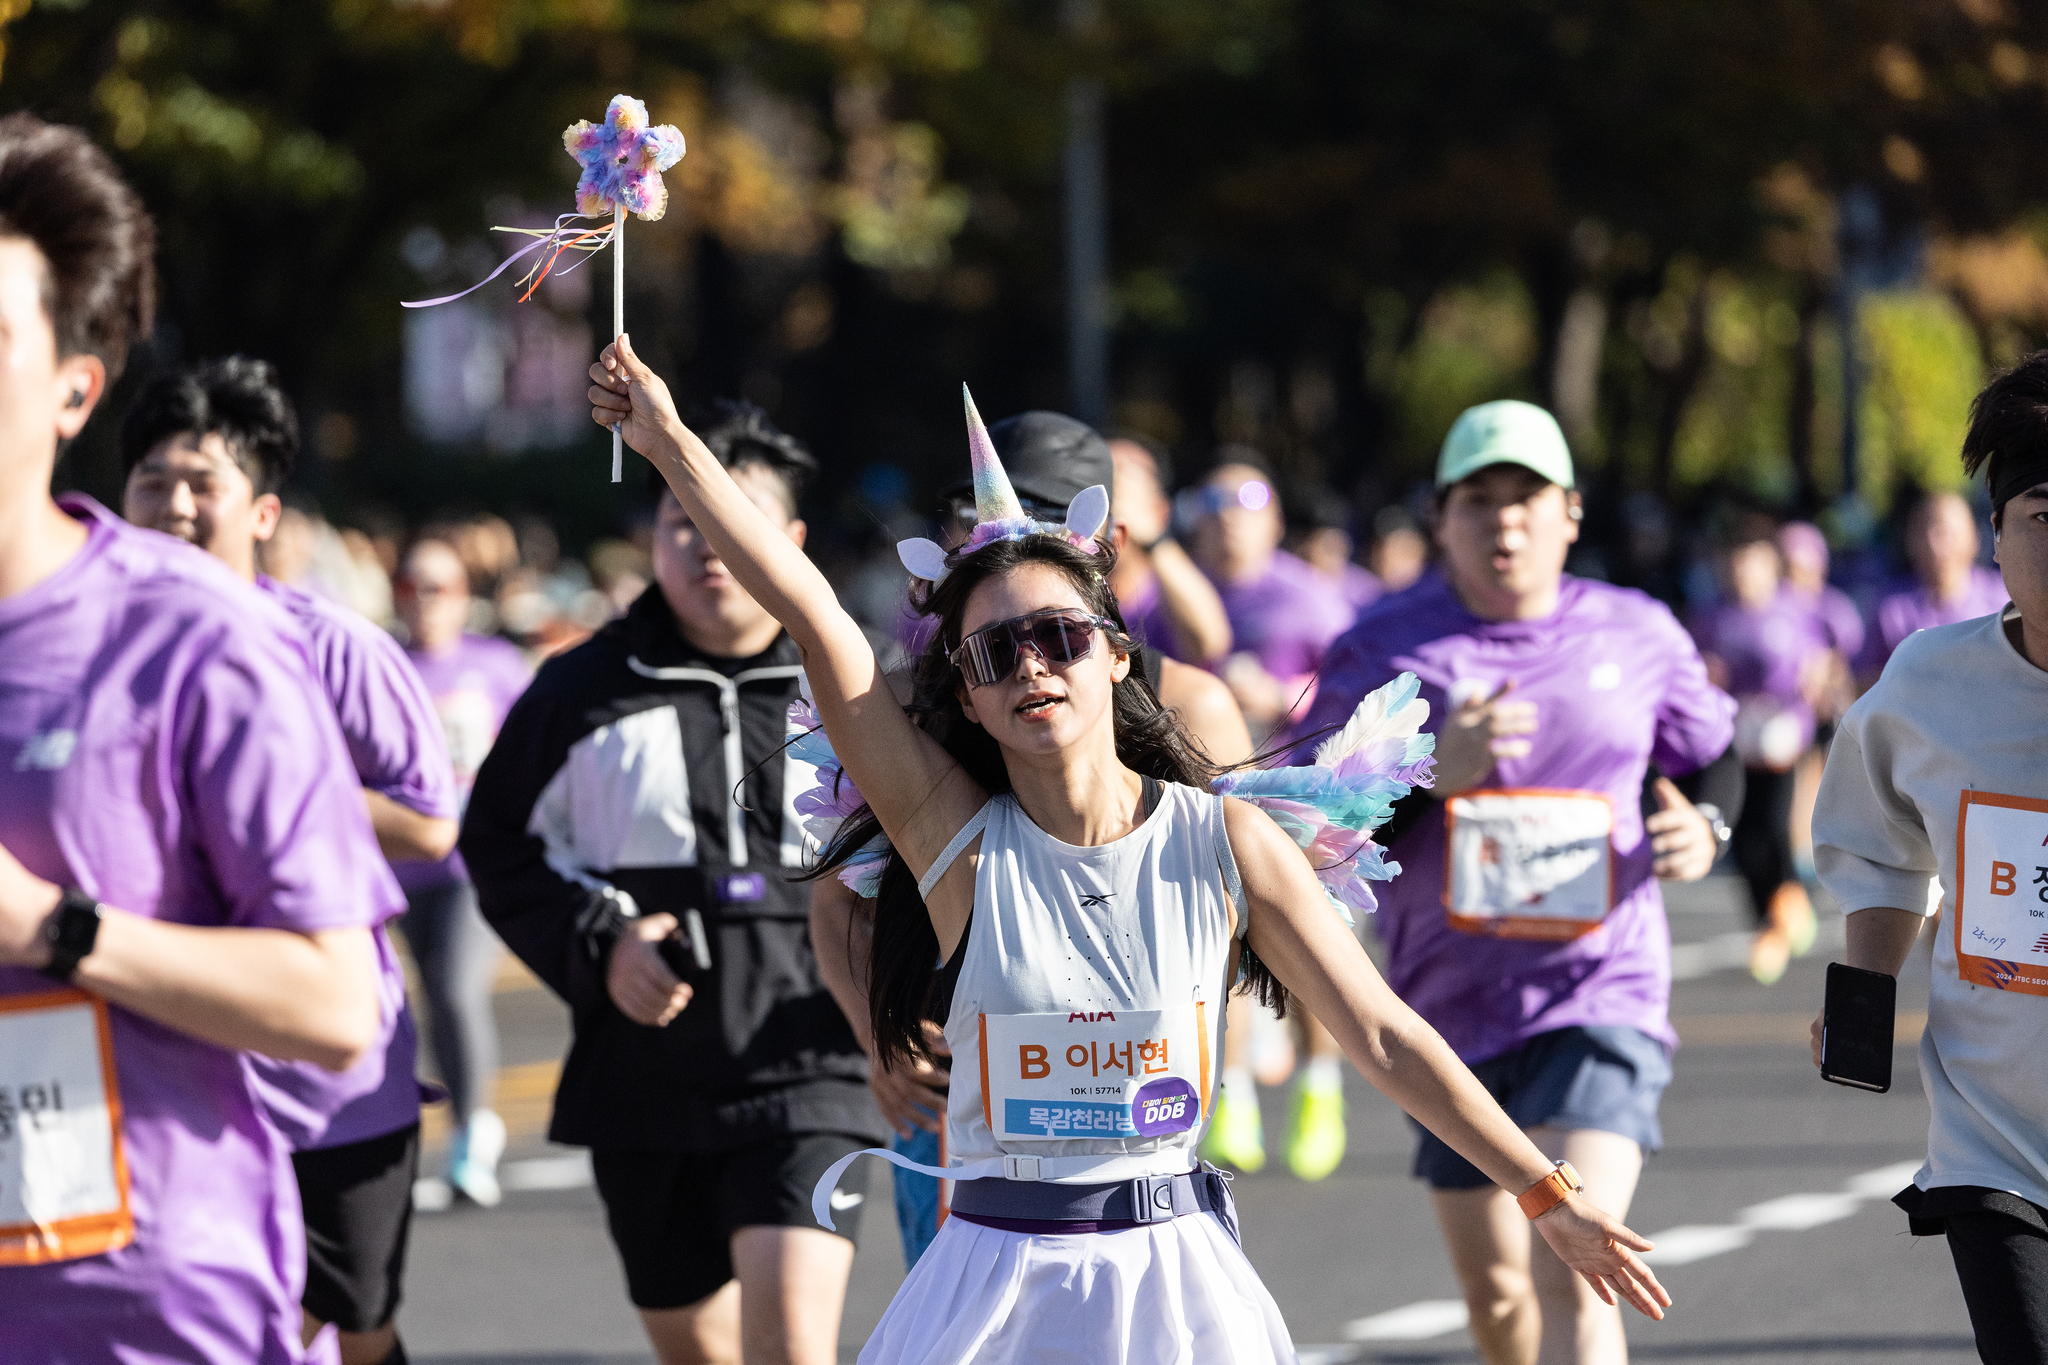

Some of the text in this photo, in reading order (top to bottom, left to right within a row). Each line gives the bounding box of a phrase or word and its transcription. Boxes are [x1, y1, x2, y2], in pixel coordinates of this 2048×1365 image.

[1990, 860, 2017, 897] B
[2029, 909, 2045, 919] 10K
[1996, 972, 2048, 986] 2024 JTBC SEO
[1019, 1038, 1169, 1080] B 이서현
[1070, 1087, 1087, 1096] 10K
[1095, 1086, 1121, 1095] 57714
[1144, 1102, 1186, 1124] DDB
